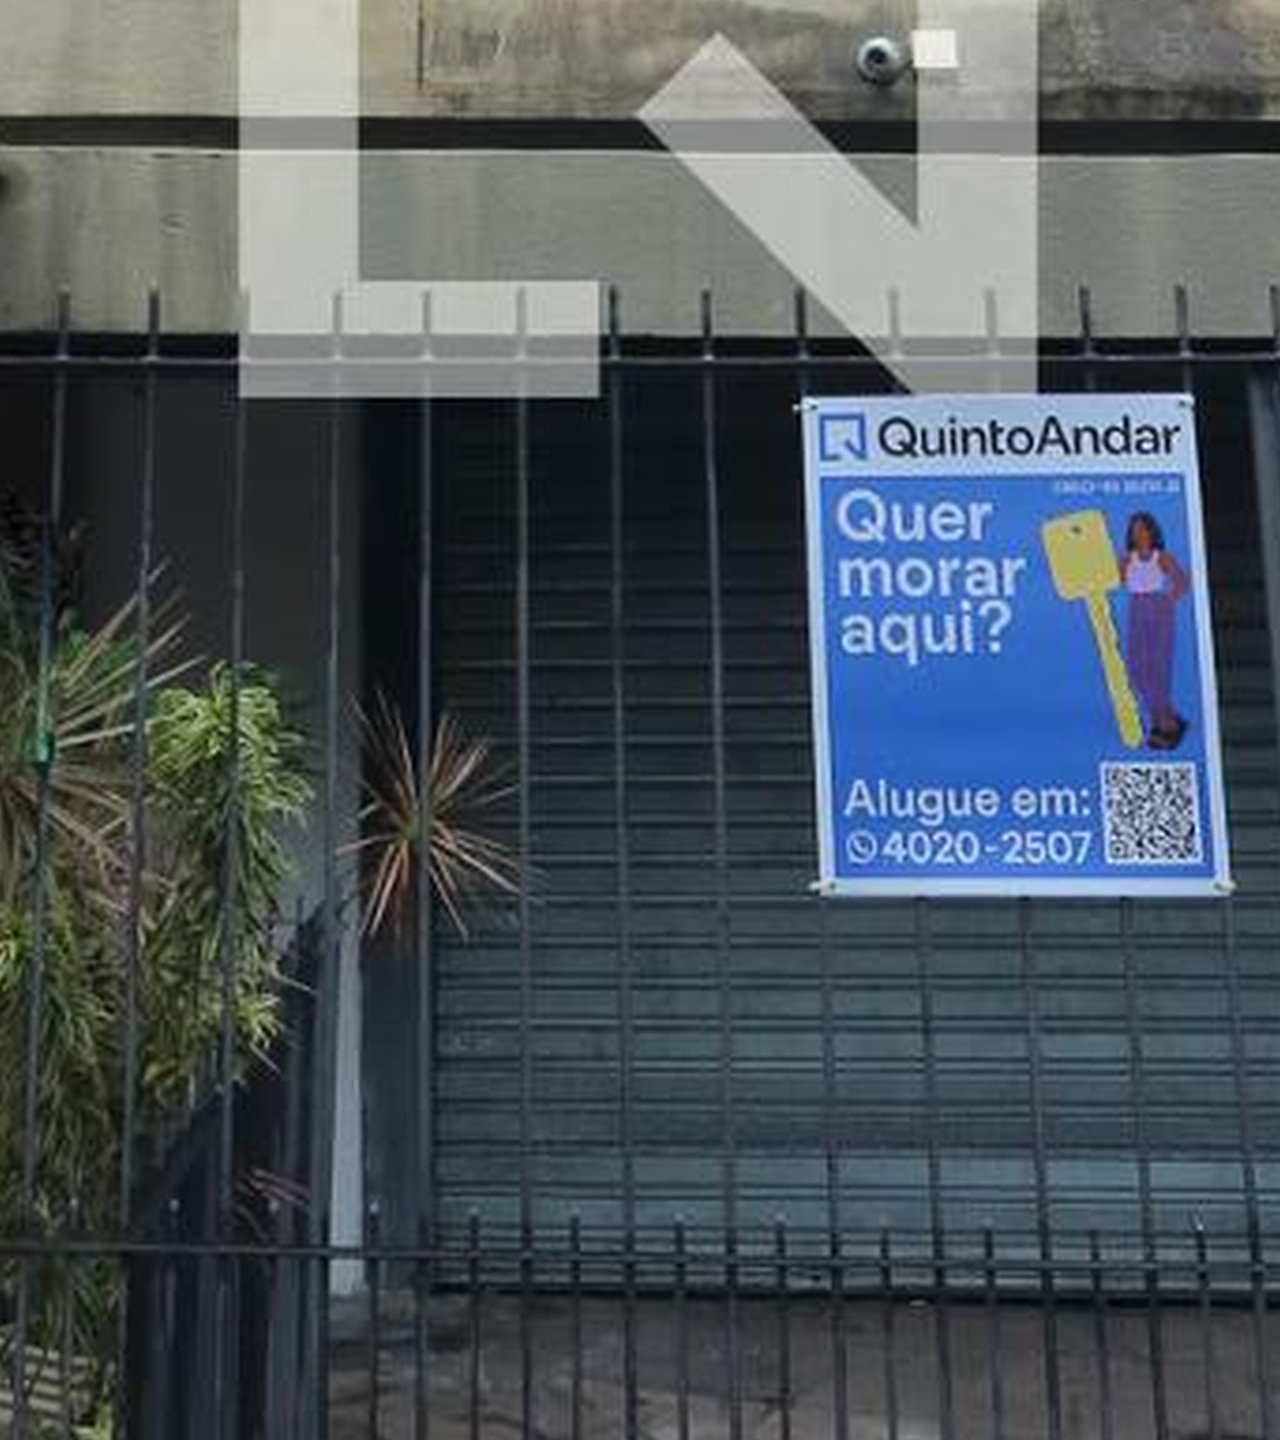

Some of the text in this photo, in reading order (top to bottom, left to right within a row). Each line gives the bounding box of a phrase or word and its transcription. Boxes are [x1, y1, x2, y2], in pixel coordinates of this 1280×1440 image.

[878, 415, 1181, 458] QuintoAndar
[837, 488, 993, 542] Quer
[839, 557, 1027, 597] morar
[841, 599, 1012, 665] aqui?
[843, 779, 1091, 826] Alugue em:
[882, 830, 1093, 864] 4020-2507
